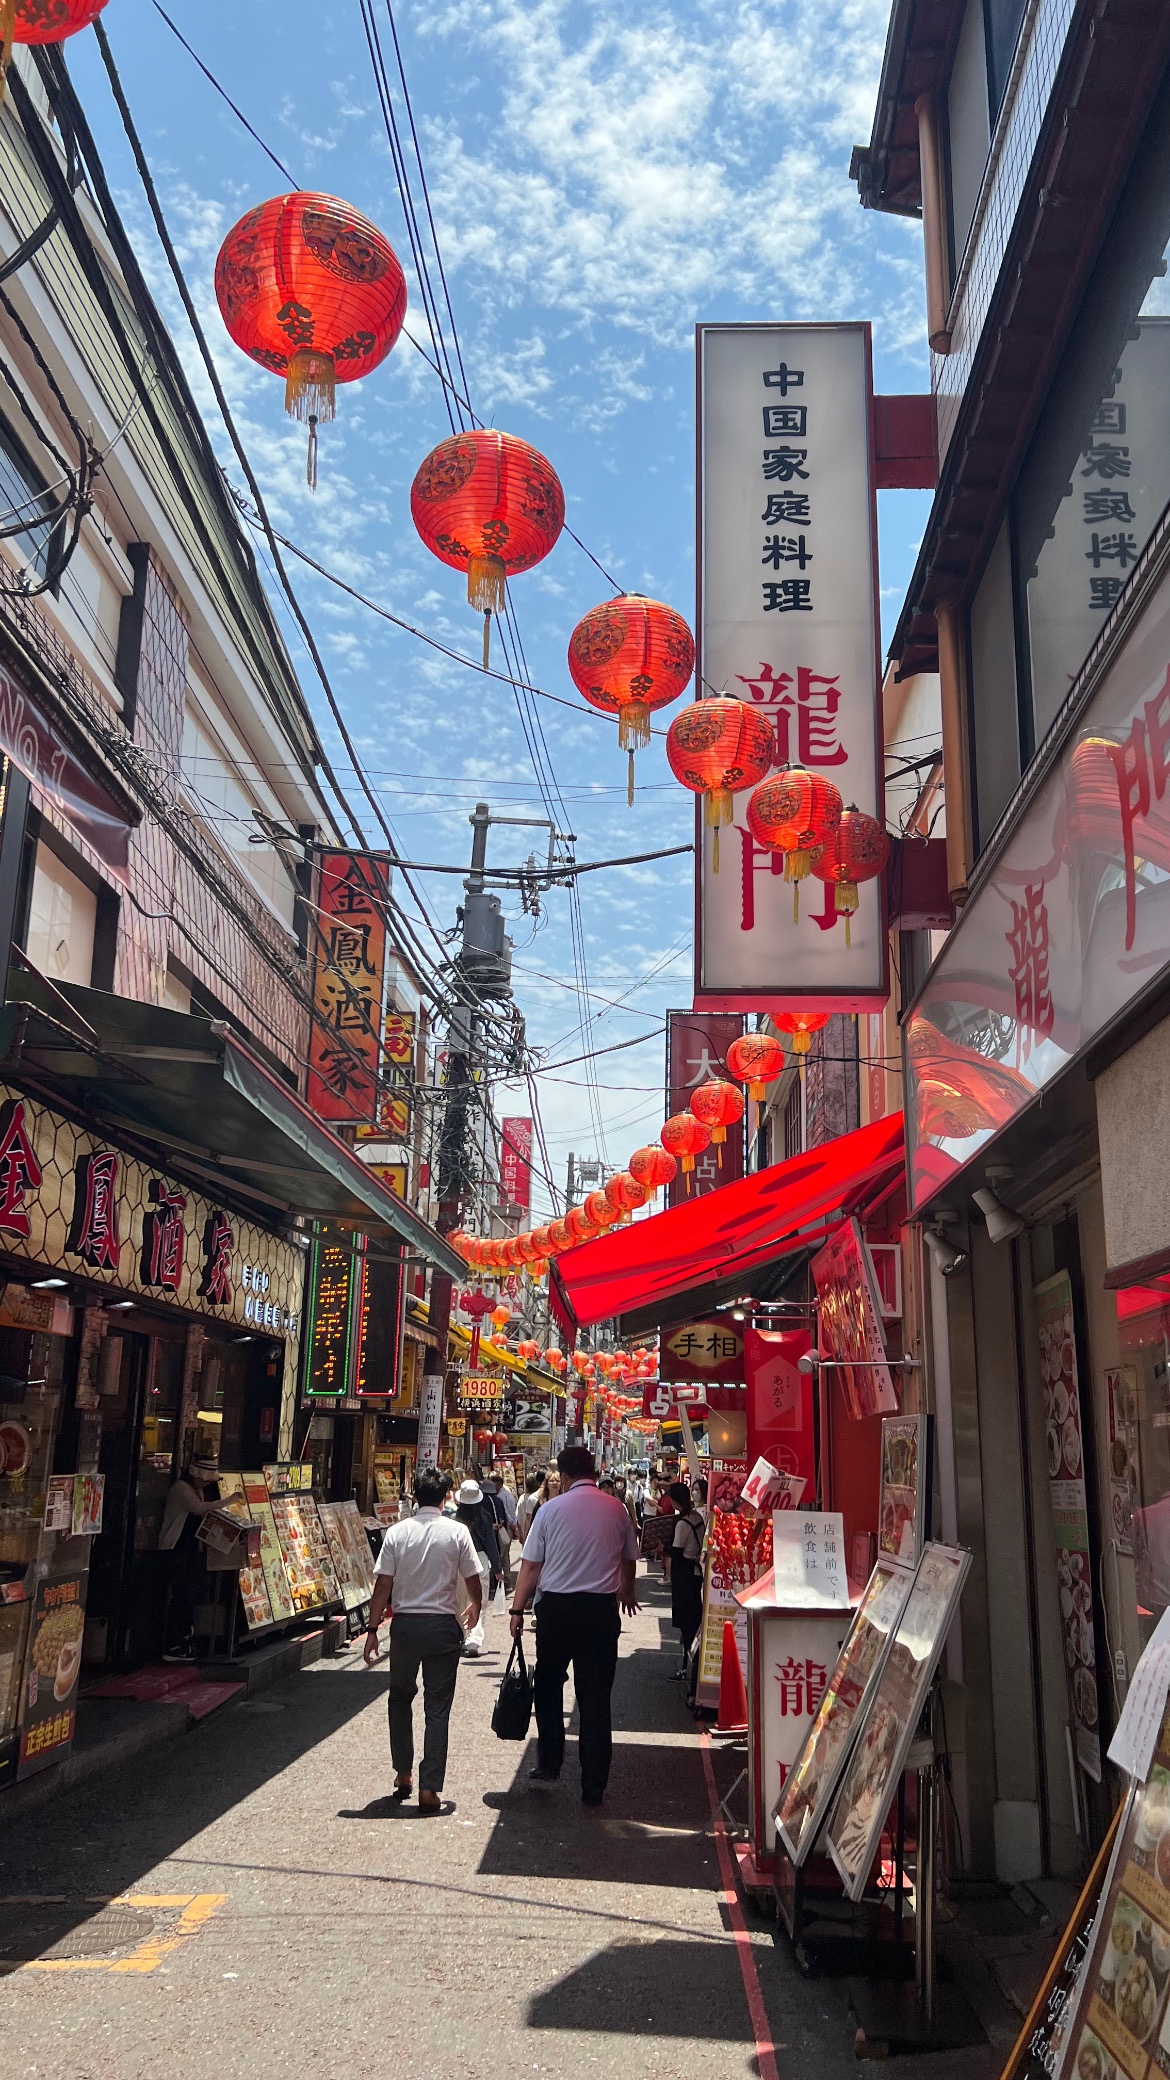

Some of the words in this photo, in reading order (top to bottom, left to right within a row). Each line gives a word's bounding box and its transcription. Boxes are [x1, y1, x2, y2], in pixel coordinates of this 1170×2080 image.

[762, 362, 814, 613] 中国家庭料理
[318, 865, 377, 1099] 金鳳酒家
[674, 1333, 737, 1358] 手相
[772, 1375, 784, 1408] あがる
[723, 1462, 748, 1472] キャンペ
[804, 1522, 818, 1569] 飲食は
